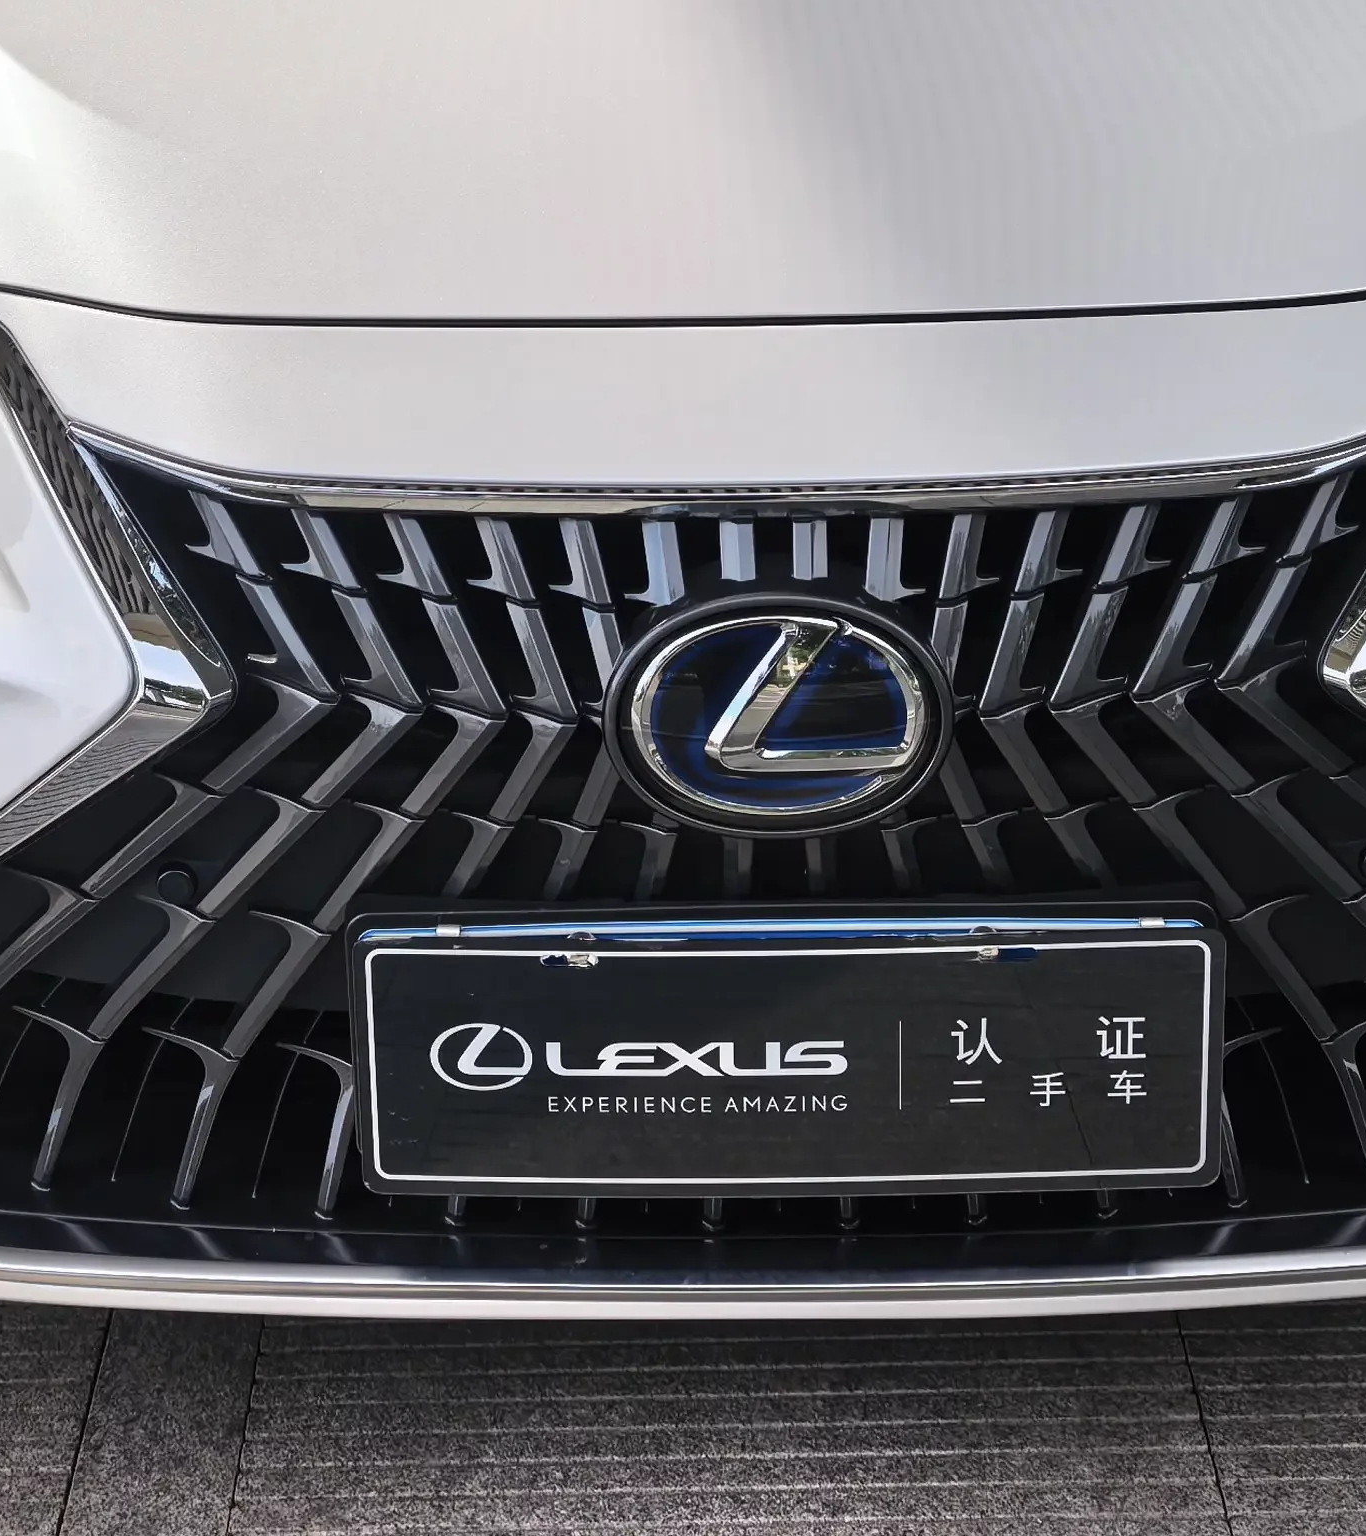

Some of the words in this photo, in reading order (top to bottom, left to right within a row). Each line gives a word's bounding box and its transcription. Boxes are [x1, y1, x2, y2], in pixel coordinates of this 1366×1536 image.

[546, 1040, 849, 1077] LEXUS
[547, 1095, 712, 1114] EXPERIENCE
[724, 1094, 849, 1113] AMAZING
